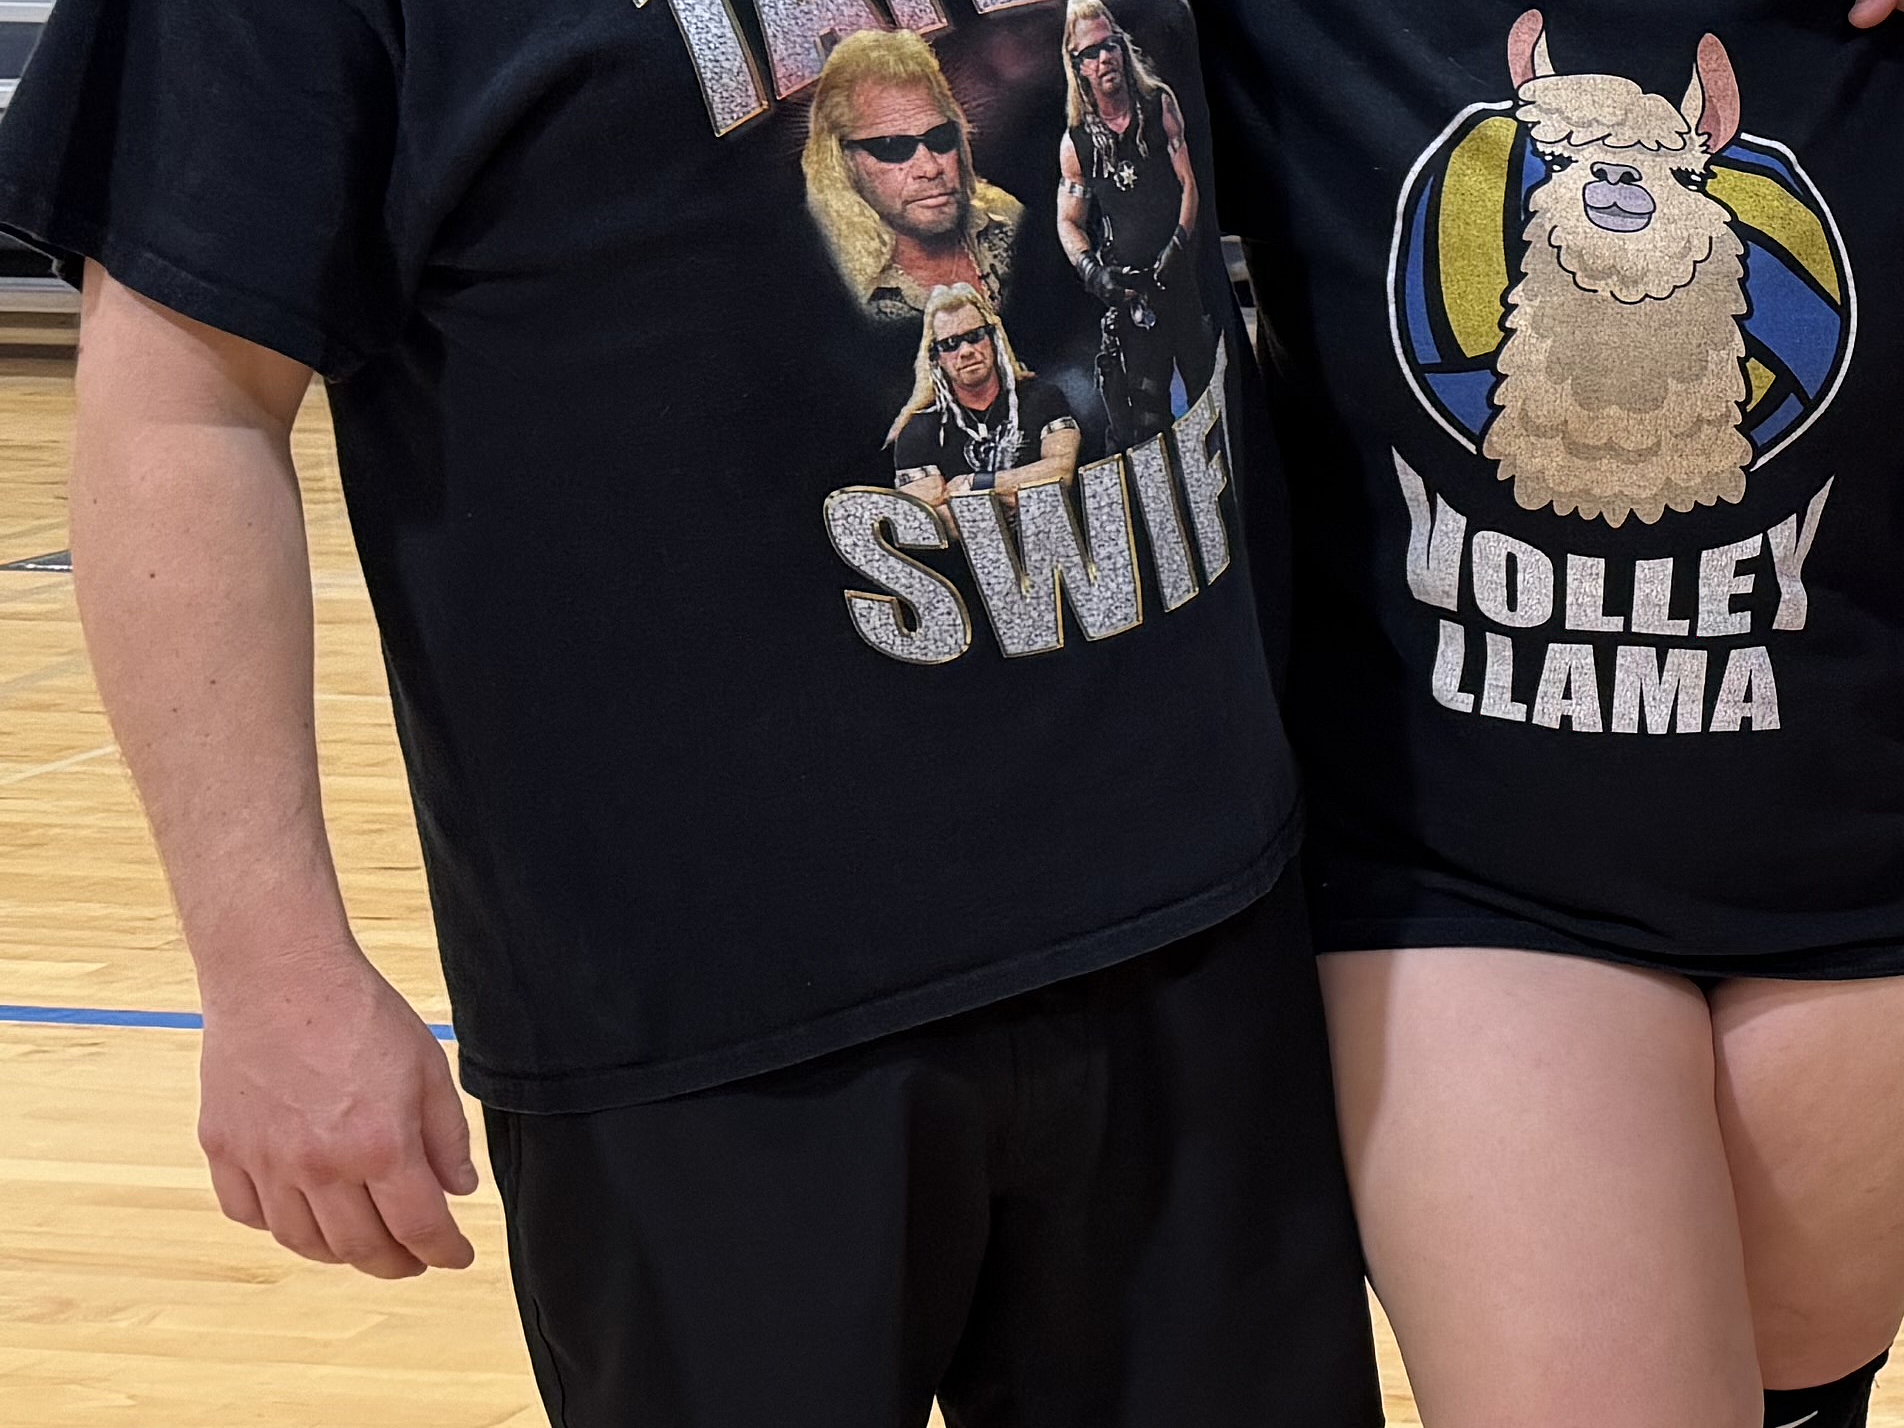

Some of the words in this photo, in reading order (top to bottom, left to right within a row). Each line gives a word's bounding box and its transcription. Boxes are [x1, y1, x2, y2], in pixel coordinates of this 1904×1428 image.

[822, 329, 1238, 666] SWIF
[1391, 445, 1836, 637] VOLLEY
[1431, 618, 1782, 735] LLAMA
